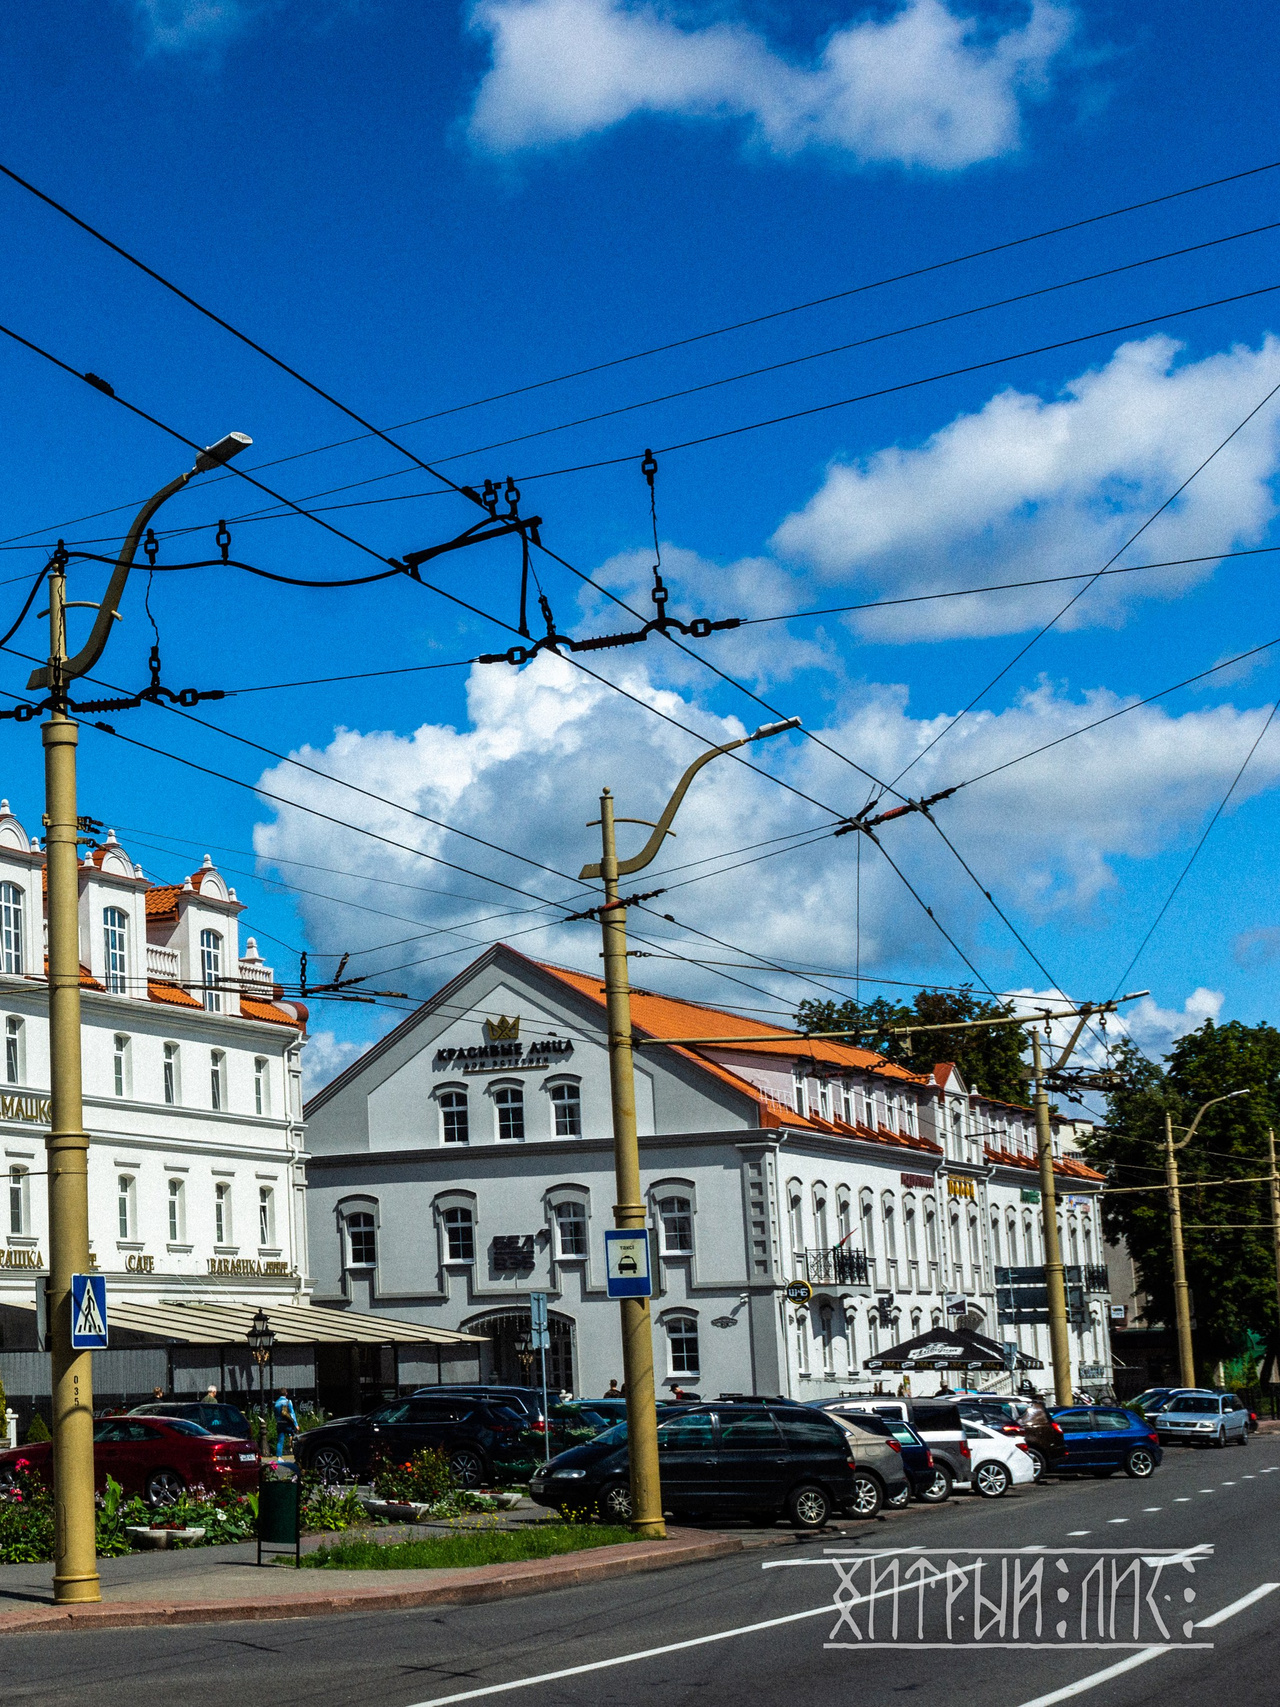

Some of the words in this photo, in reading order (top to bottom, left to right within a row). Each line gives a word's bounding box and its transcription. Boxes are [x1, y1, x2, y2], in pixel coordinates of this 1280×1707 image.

[437, 1042, 523, 1061] КРАСИВЫЕ
[529, 1039, 575, 1054] ЛИЦА
[128, 1254, 155, 1271] CAFE
[210, 1257, 263, 1275] BARASHKA
